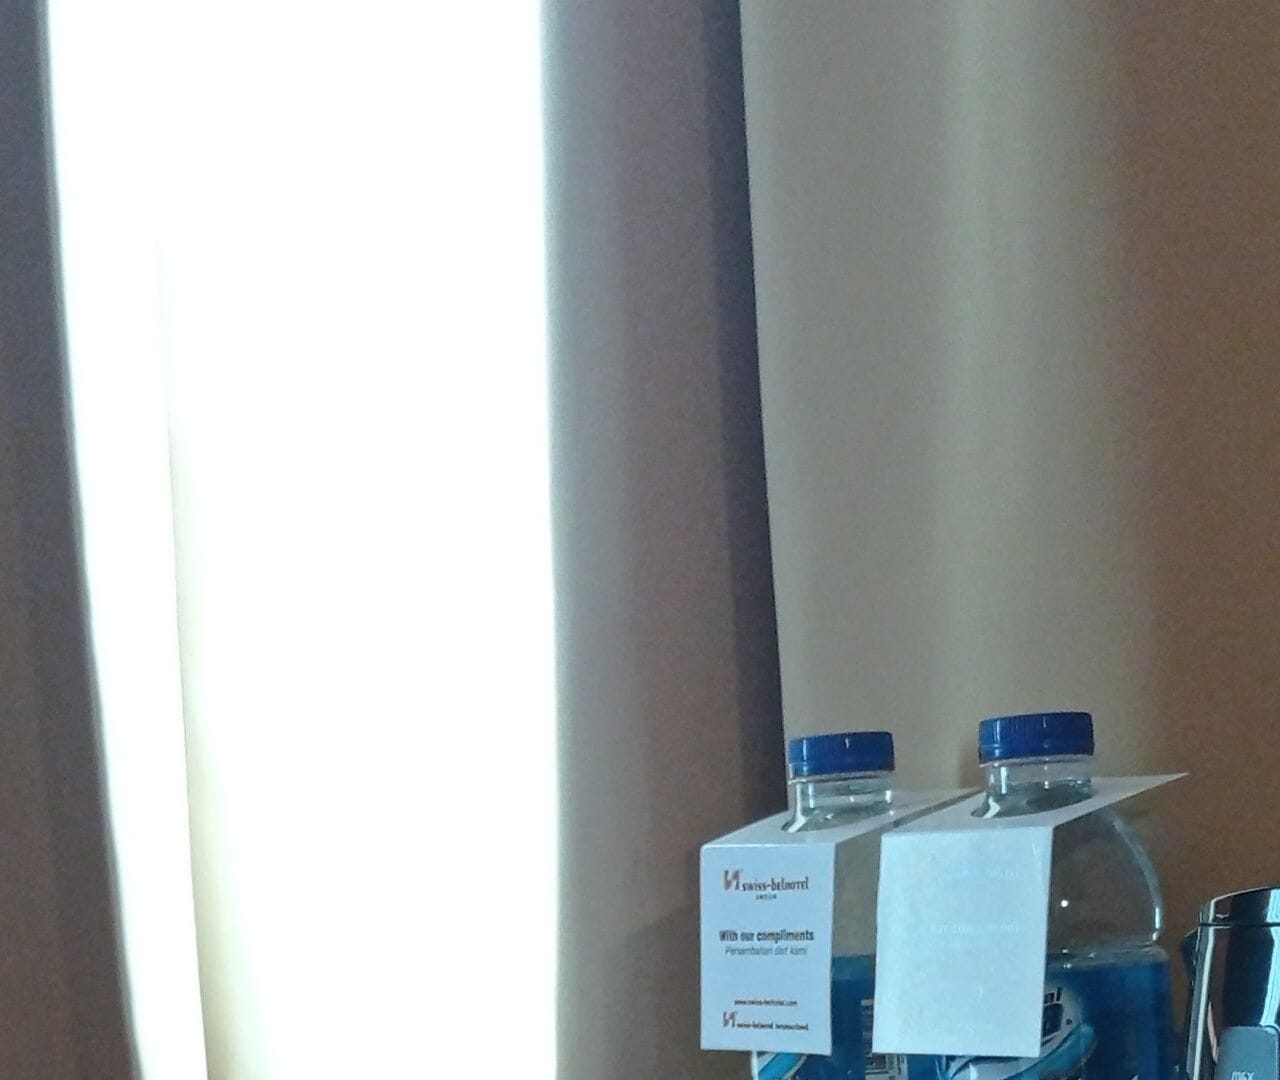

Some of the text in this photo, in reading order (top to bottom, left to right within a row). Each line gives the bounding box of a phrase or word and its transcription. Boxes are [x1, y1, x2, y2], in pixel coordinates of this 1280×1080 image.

[719, 929, 815, 944] With our compliments
